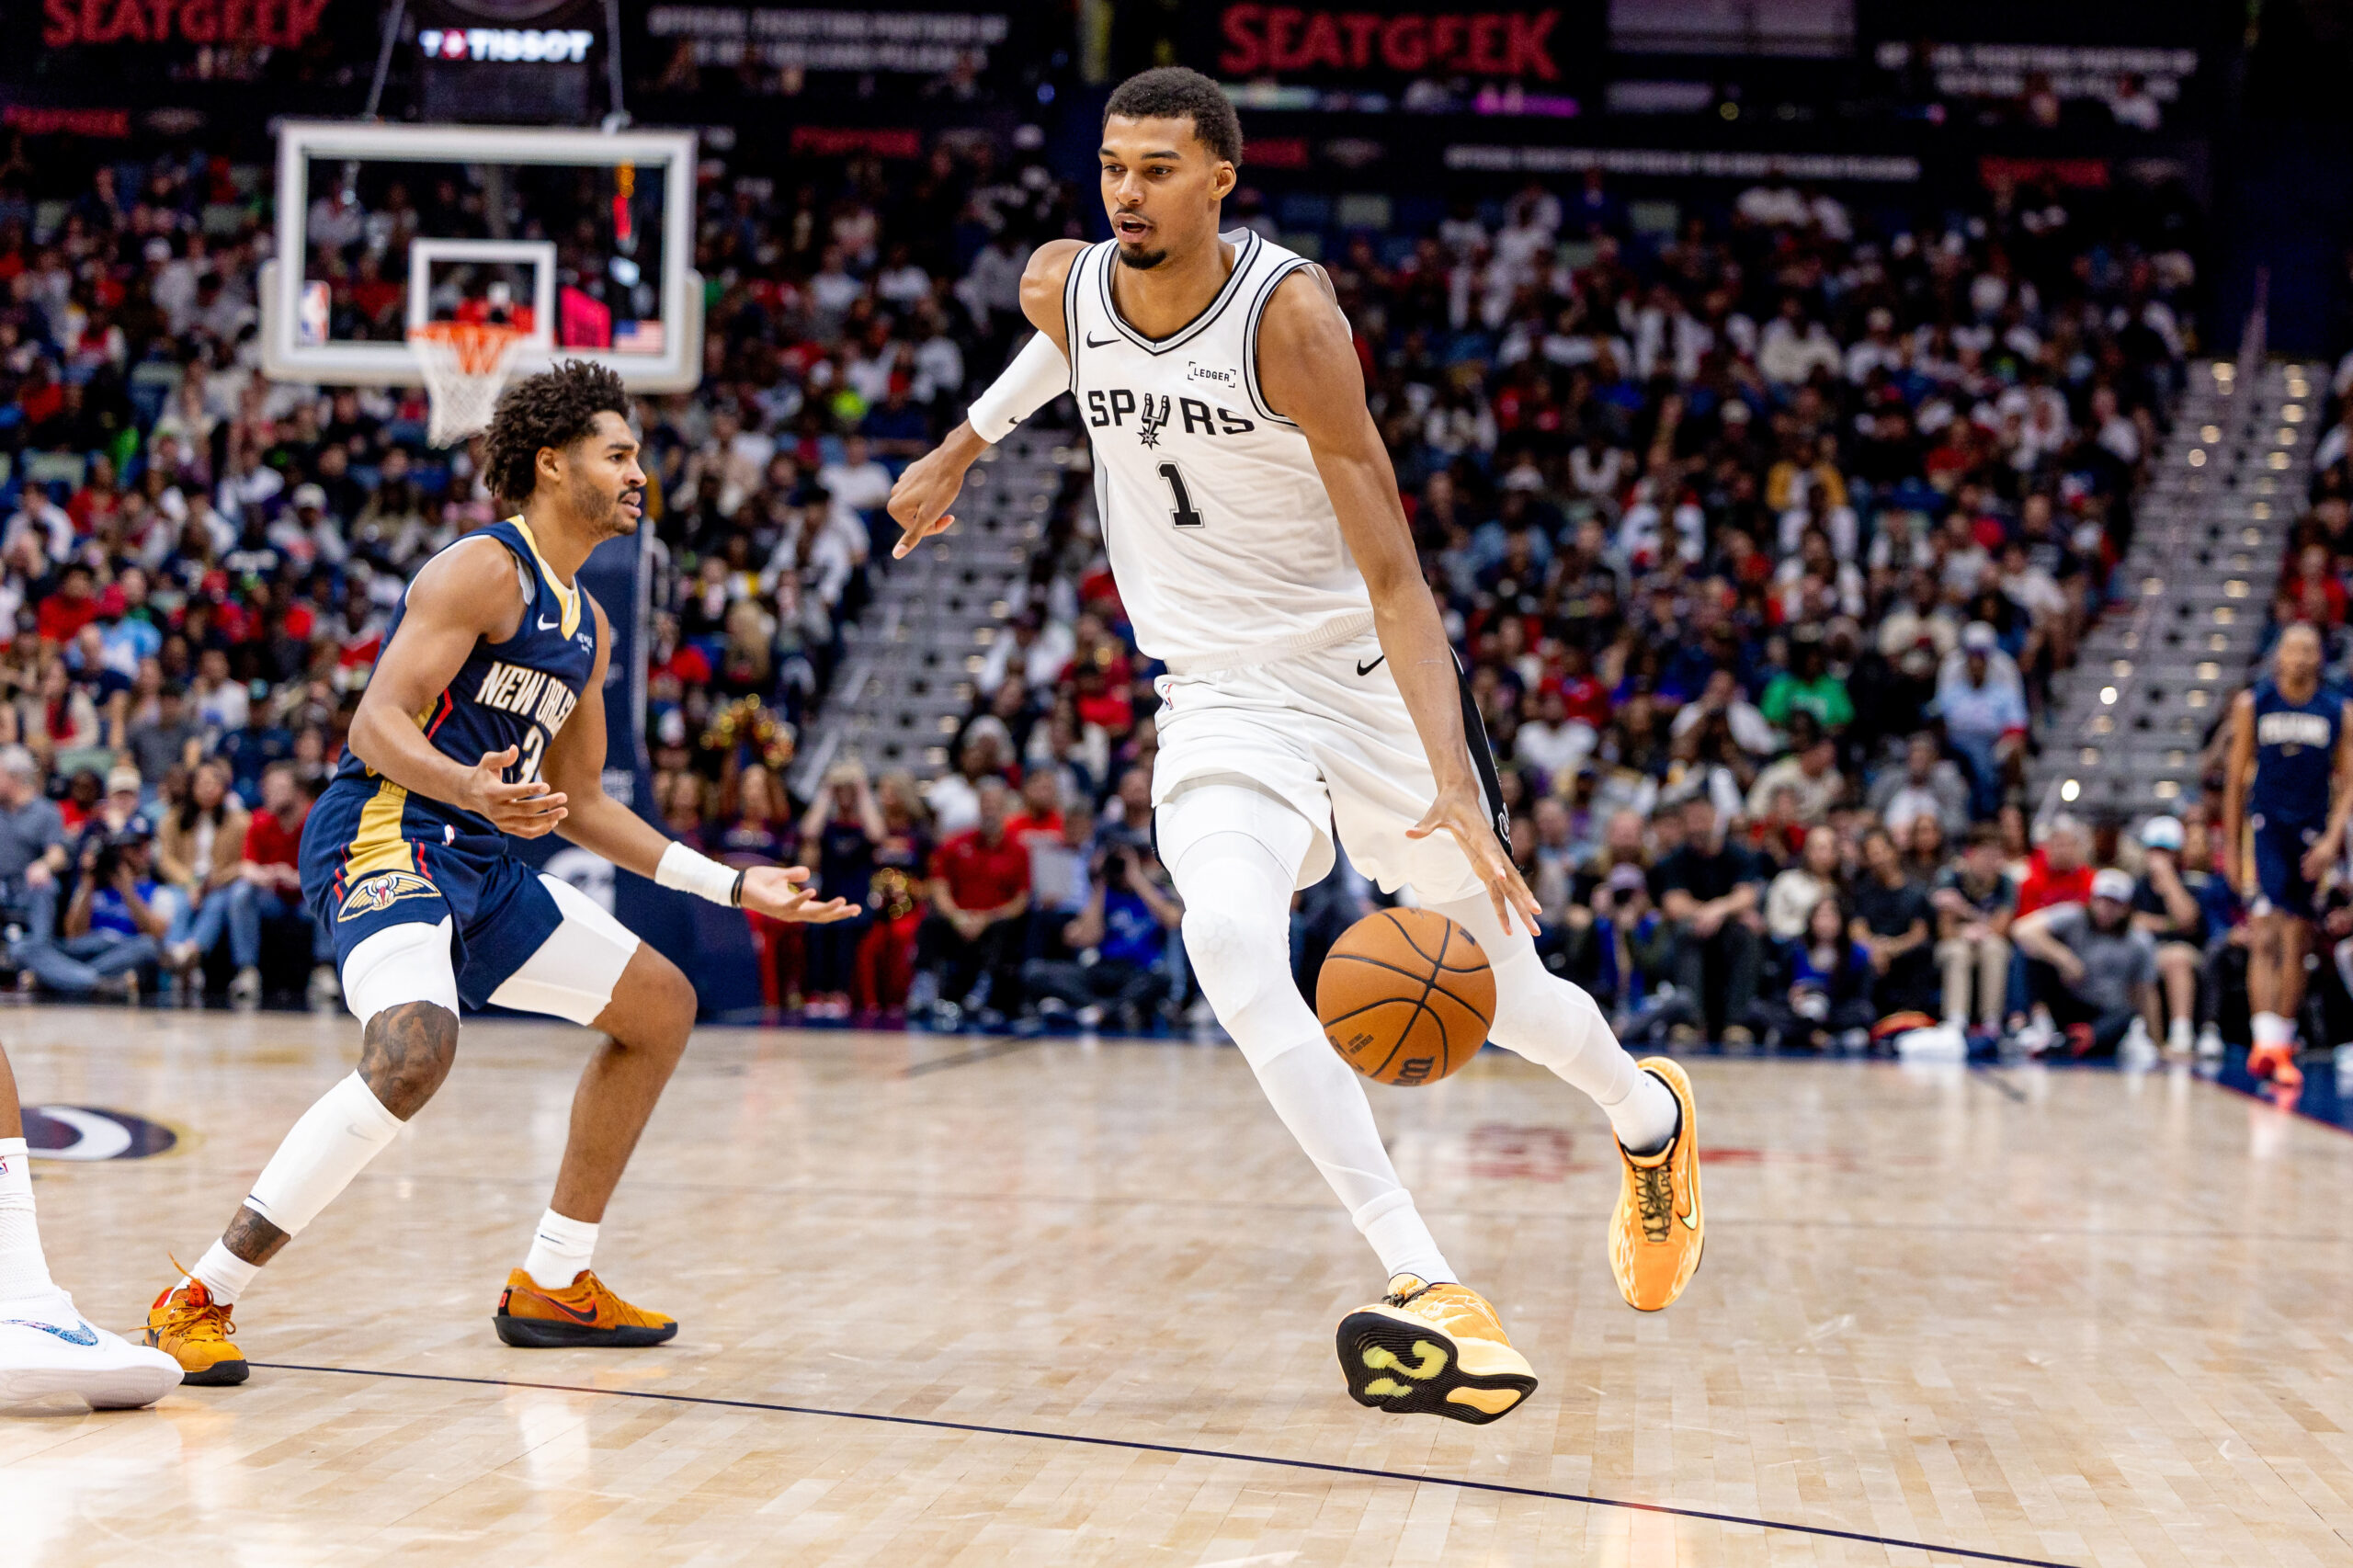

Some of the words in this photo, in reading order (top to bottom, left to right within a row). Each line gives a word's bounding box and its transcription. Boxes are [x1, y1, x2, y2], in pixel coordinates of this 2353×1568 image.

[466, 28, 594, 62] TISSOT
[1193, 367, 1230, 382] LEDGER
[1087, 389, 1256, 450] SPURS
[1155, 460, 1206, 528] 1
[474, 660, 547, 717] NEW
